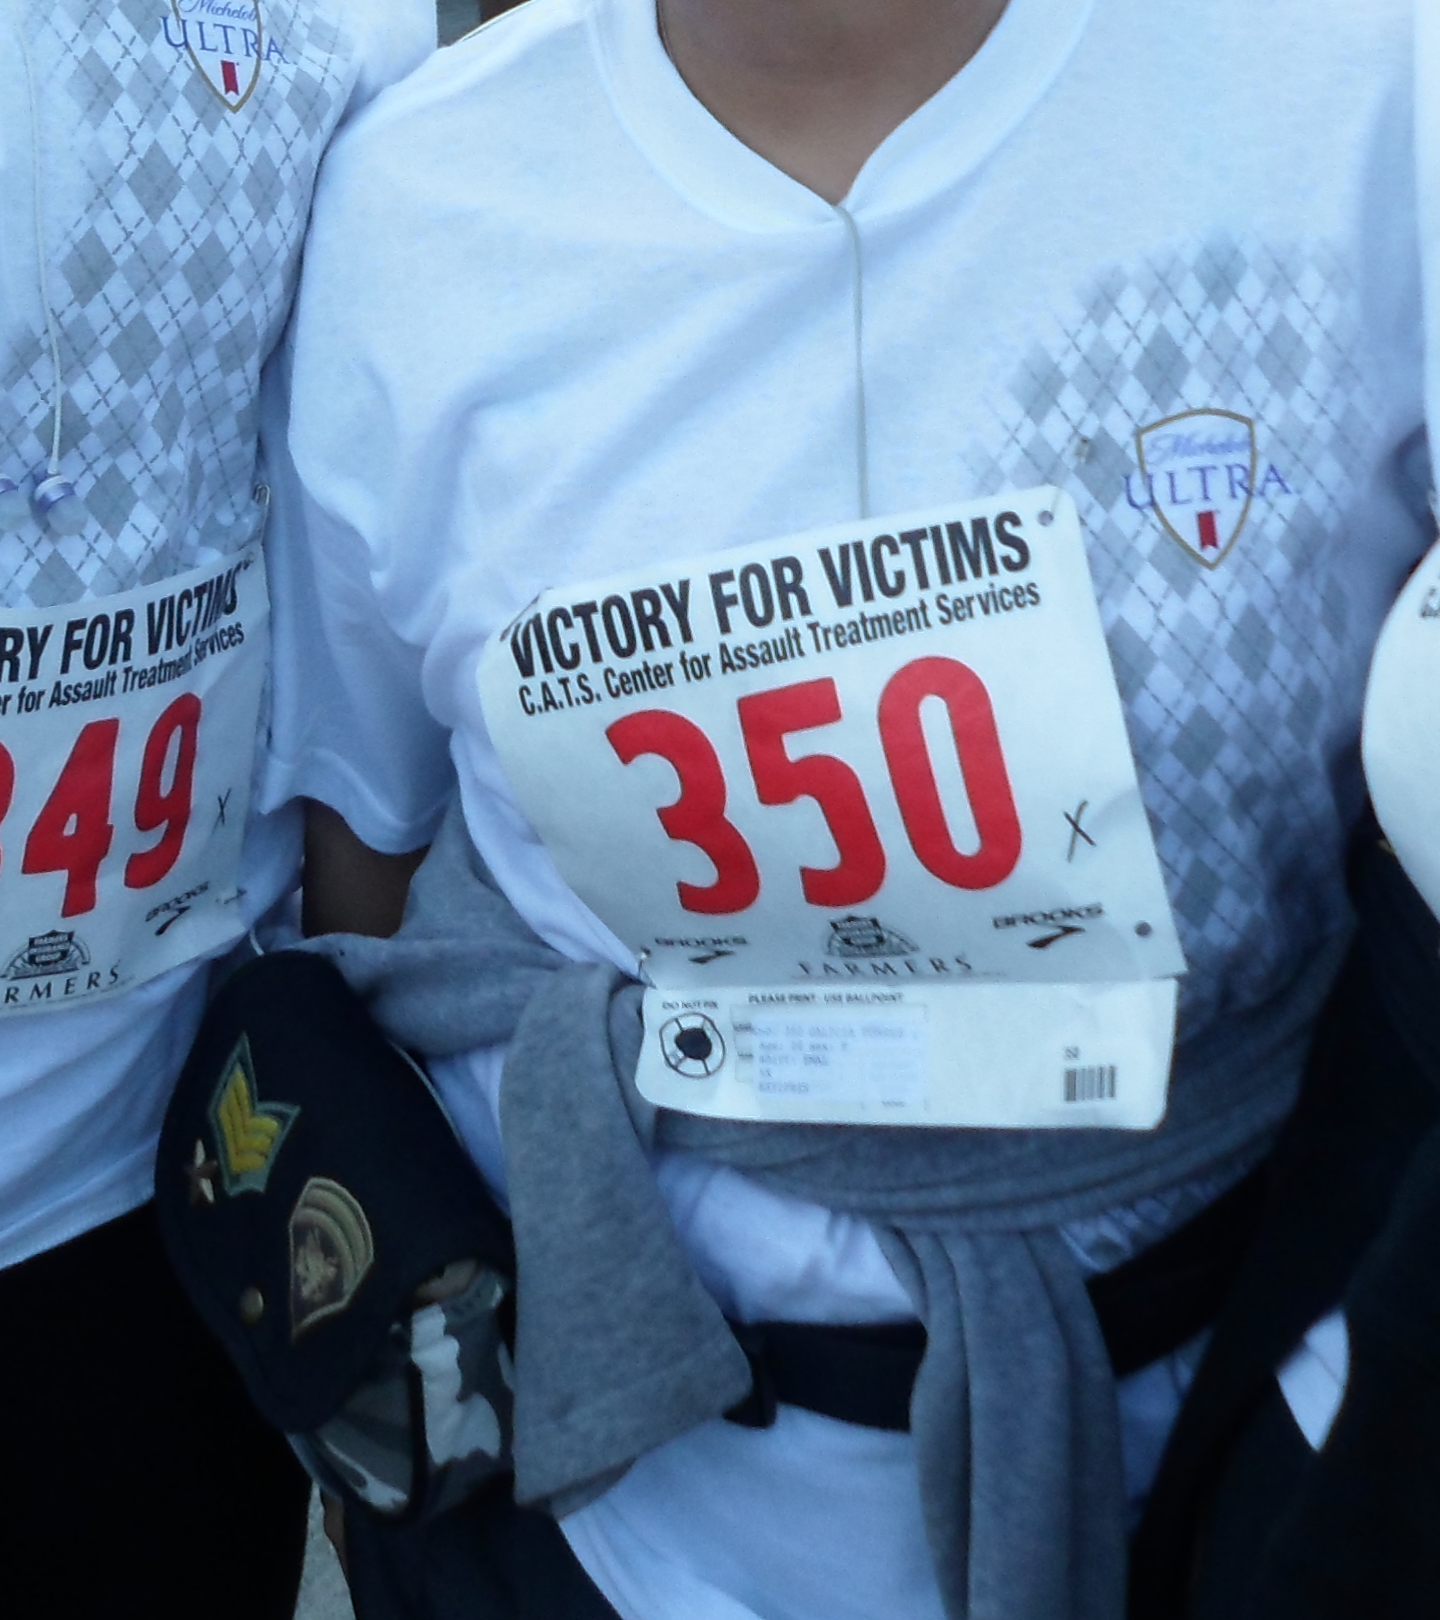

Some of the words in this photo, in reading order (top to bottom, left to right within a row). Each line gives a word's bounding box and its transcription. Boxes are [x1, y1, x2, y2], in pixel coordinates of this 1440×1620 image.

[160, 16, 290, 65] ULTRA
[1122, 462, 1292, 511] ULTRA
[59, 608, 136, 676] FOR
[146, 561, 240, 654] VICTIMS
[509, 578, 693, 679] VICTORY
[707, 554, 813, 636] FOR
[817, 510, 1032, 609] VICTIMS
[17, 684, 45, 715] for
[48, 672, 117, 709] Assault
[193, 620, 245, 667] Services
[517, 671, 603, 717] C.A.T.S.
[603, 658, 675, 700] Center
[679, 648, 712, 684] for
[718, 627, 805, 675] Assault
[806, 599, 933, 654] Treatment
[935, 581, 1041, 628] Services
[604, 655, 1023, 915] 350
[991, 903, 1105, 929] BROOKS
[797, 956, 975, 977] FARMERS
